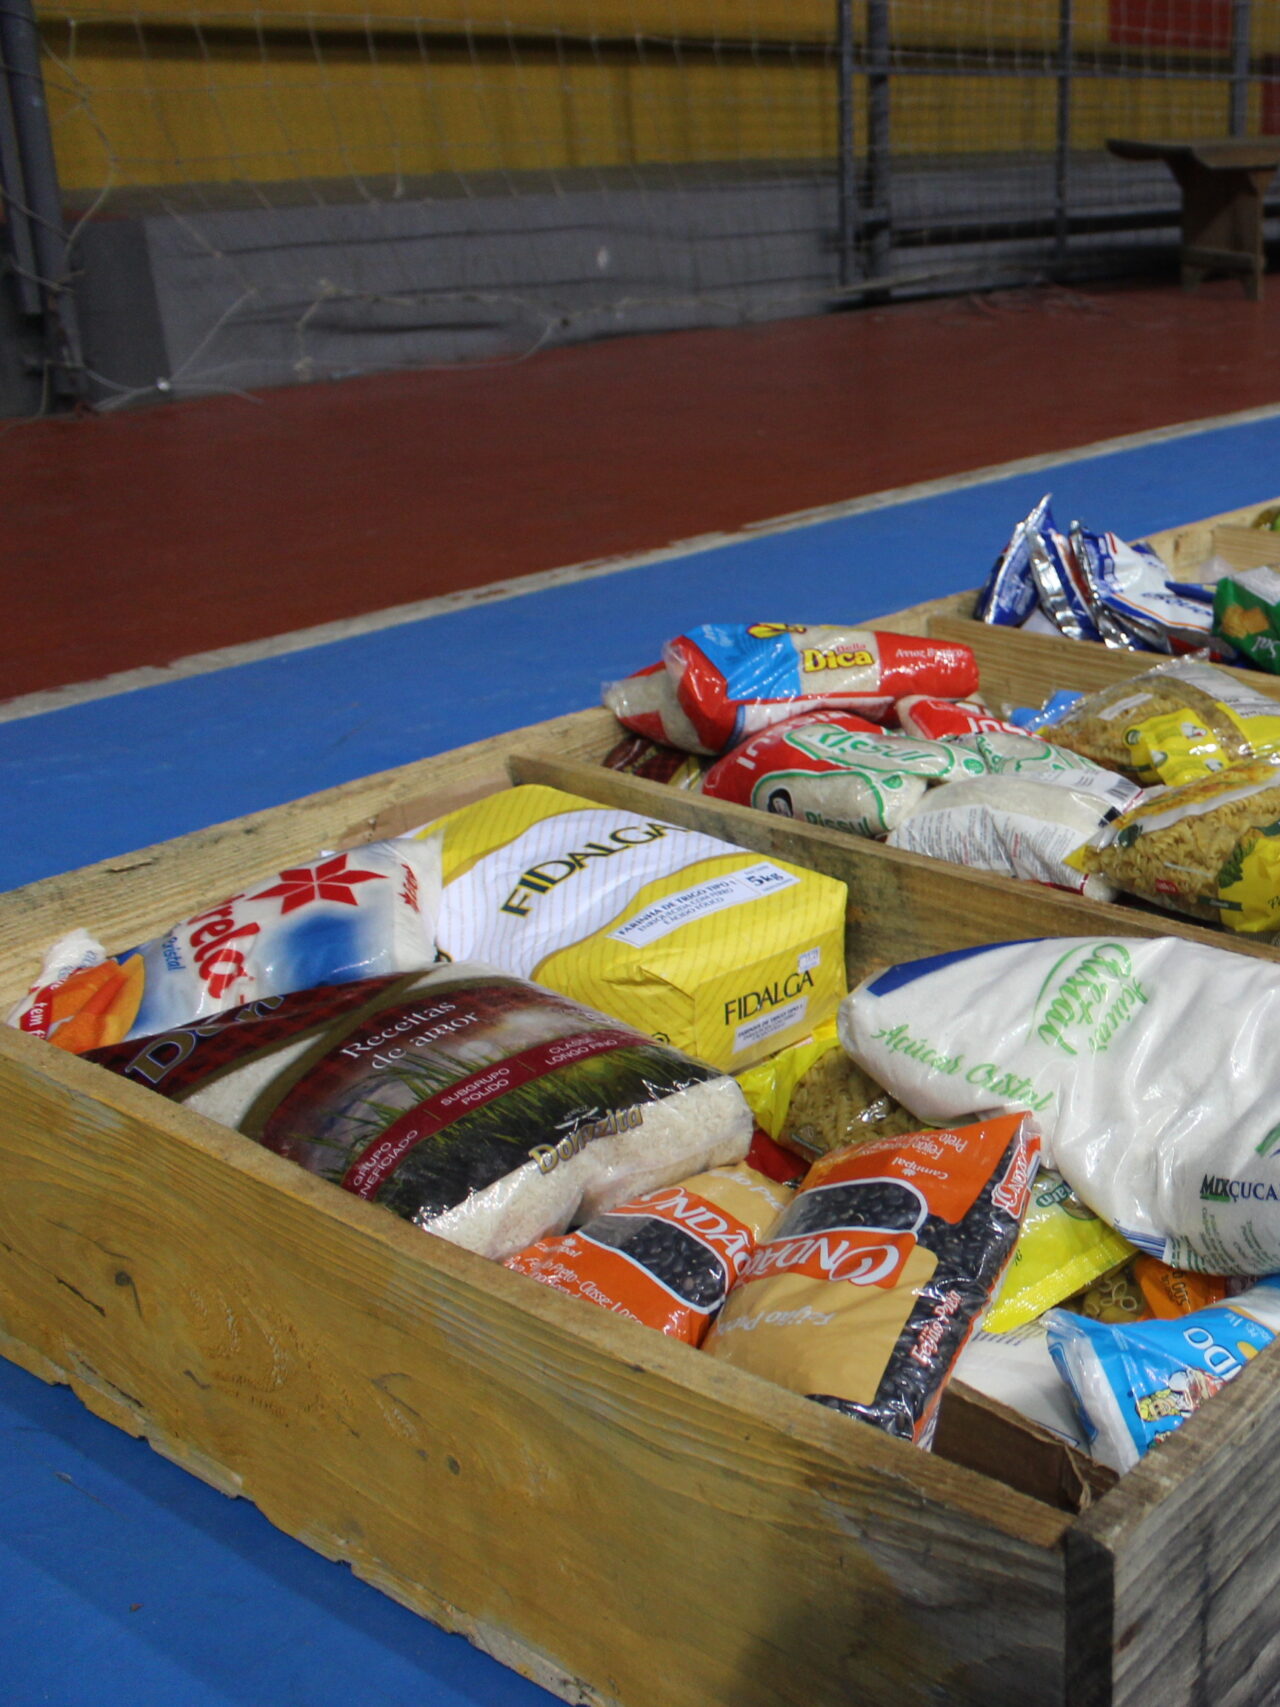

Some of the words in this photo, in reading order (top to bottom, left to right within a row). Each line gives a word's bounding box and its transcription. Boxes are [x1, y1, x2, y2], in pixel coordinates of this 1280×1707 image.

[802, 649, 875, 673] Dica
[501, 822, 690, 918] FIDALGA
[748, 870, 785, 888] 5kg
[618, 908, 661, 935] FARINHA
[662, 900, 676, 912] DE
[676, 888, 706, 904] TRIGO
[708, 880, 730, 891] TIPO
[724, 969, 815, 1026] FIDALGA
[341, 1001, 456, 1059] Receitas
[371, 1044, 406, 1070] de
[410, 1011, 481, 1047] amor
[545, 1046, 589, 1066] LONGO
[441, 1067, 510, 1106] SUBGRUPO
[461, 1079, 509, 1105] POLIDO
[965, 1062, 1055, 1112] Cristal
[352, 1141, 392, 1187] GRUPO
[359, 1129, 418, 1200] ENEFICIADO
[939, 1134, 968, 1152] Preto
